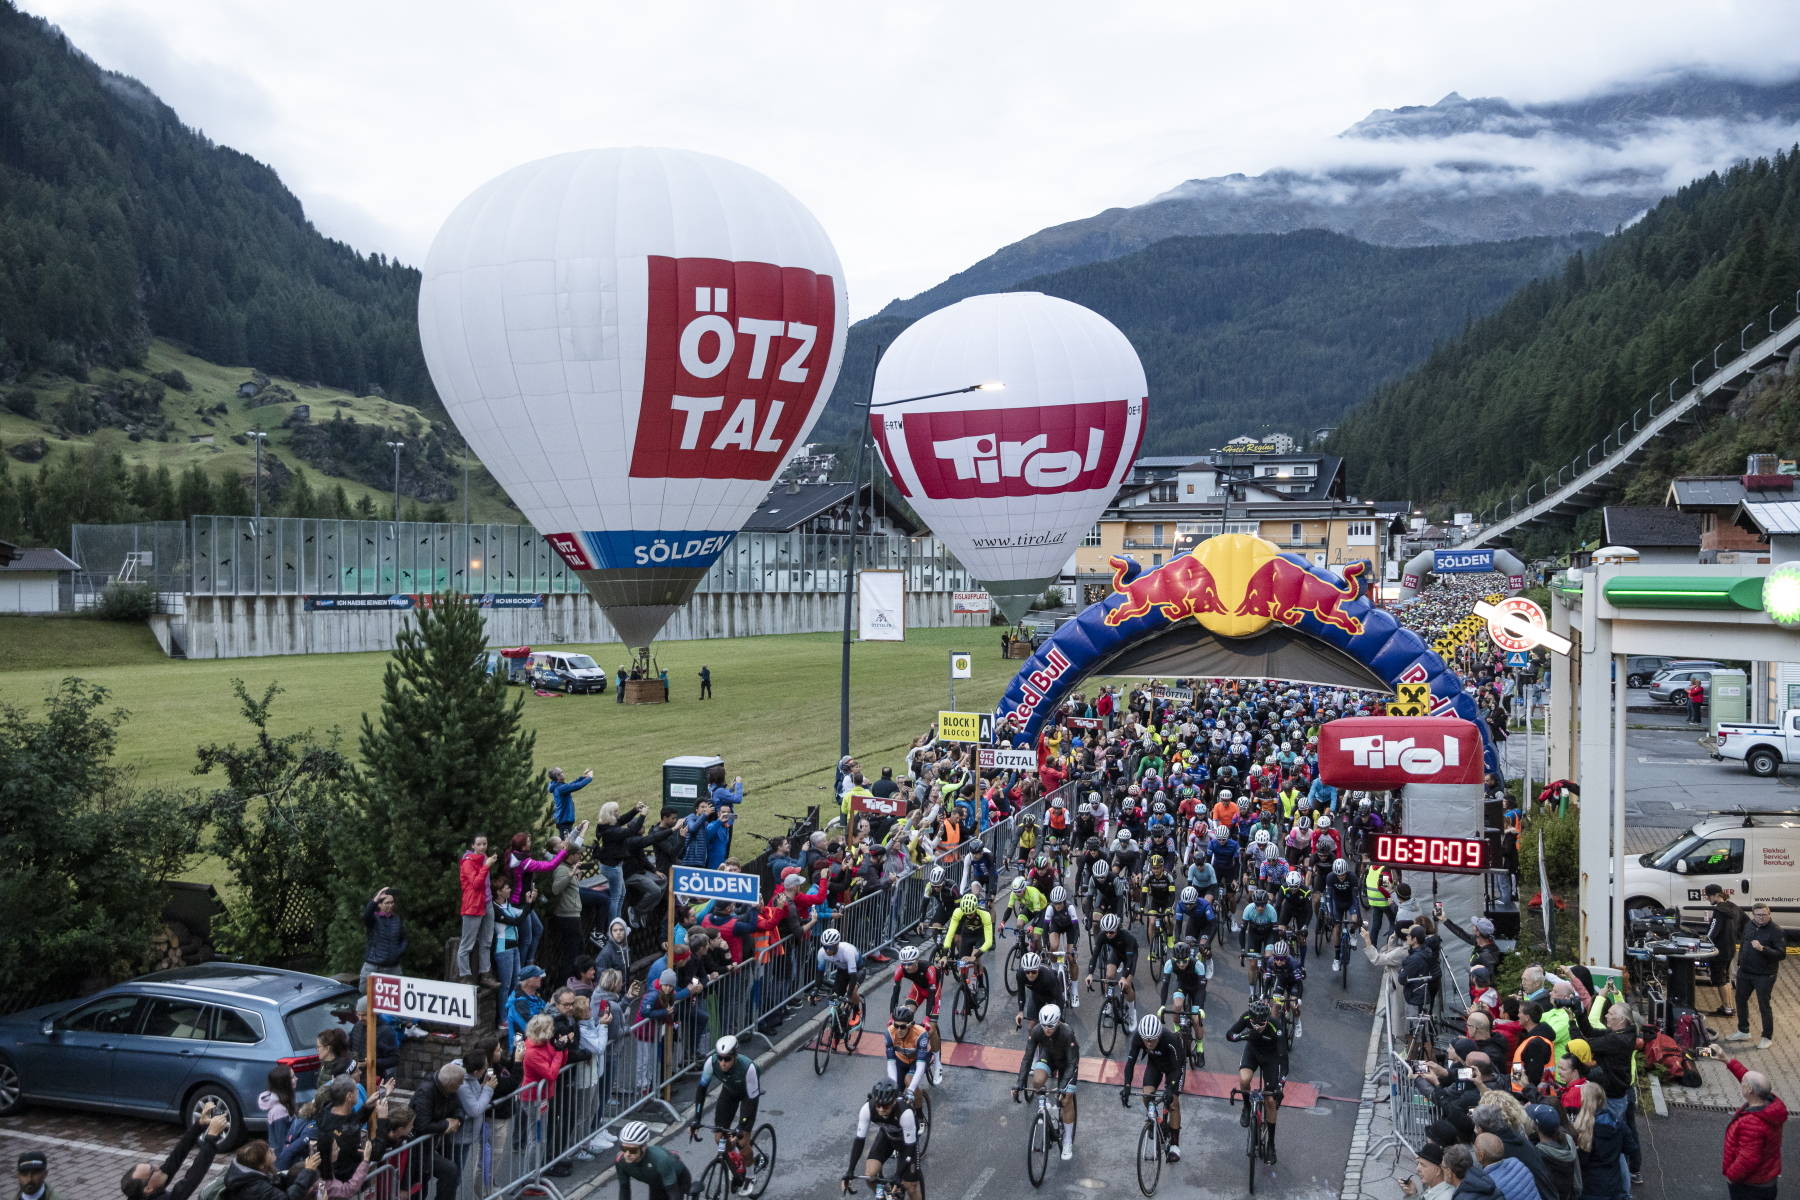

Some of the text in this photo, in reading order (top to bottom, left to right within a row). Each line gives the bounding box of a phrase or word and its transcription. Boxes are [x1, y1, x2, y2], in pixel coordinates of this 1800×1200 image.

[680, 287, 817, 383] ÖTZ
[671, 395, 784, 452] TAL
[933, 427, 1104, 487] Tirol
[1222, 443, 1275, 453] Hotel Regina
[552, 538, 577, 553] ÖTZ
[972, 531, 1067, 548] www.tirol.at
[634, 535, 731, 565] SÖLDEN
[566, 554, 585, 566] TAL
[1437, 554, 1490, 569] SÖLDEN
[1028, 648, 1071, 694] Bull
[1400, 662, 1451, 714] Rd
[943, 717, 975, 727] BLOCK 1
[980, 718, 990, 738] A
[943, 728, 969, 736] BLOCCO
[996, 752, 1034, 766] ÖTZTAL
[1339, 734, 1460, 775] Tirol
[862, 798, 898, 814] Tirol
[1377, 836, 1481, 867] 06:30:09
[679, 873, 752, 893] SÖLDEN
[375, 978, 399, 996] ÖTZ
[375, 995, 399, 1009] TAL
[404, 983, 472, 1019] ÖTZTAL
